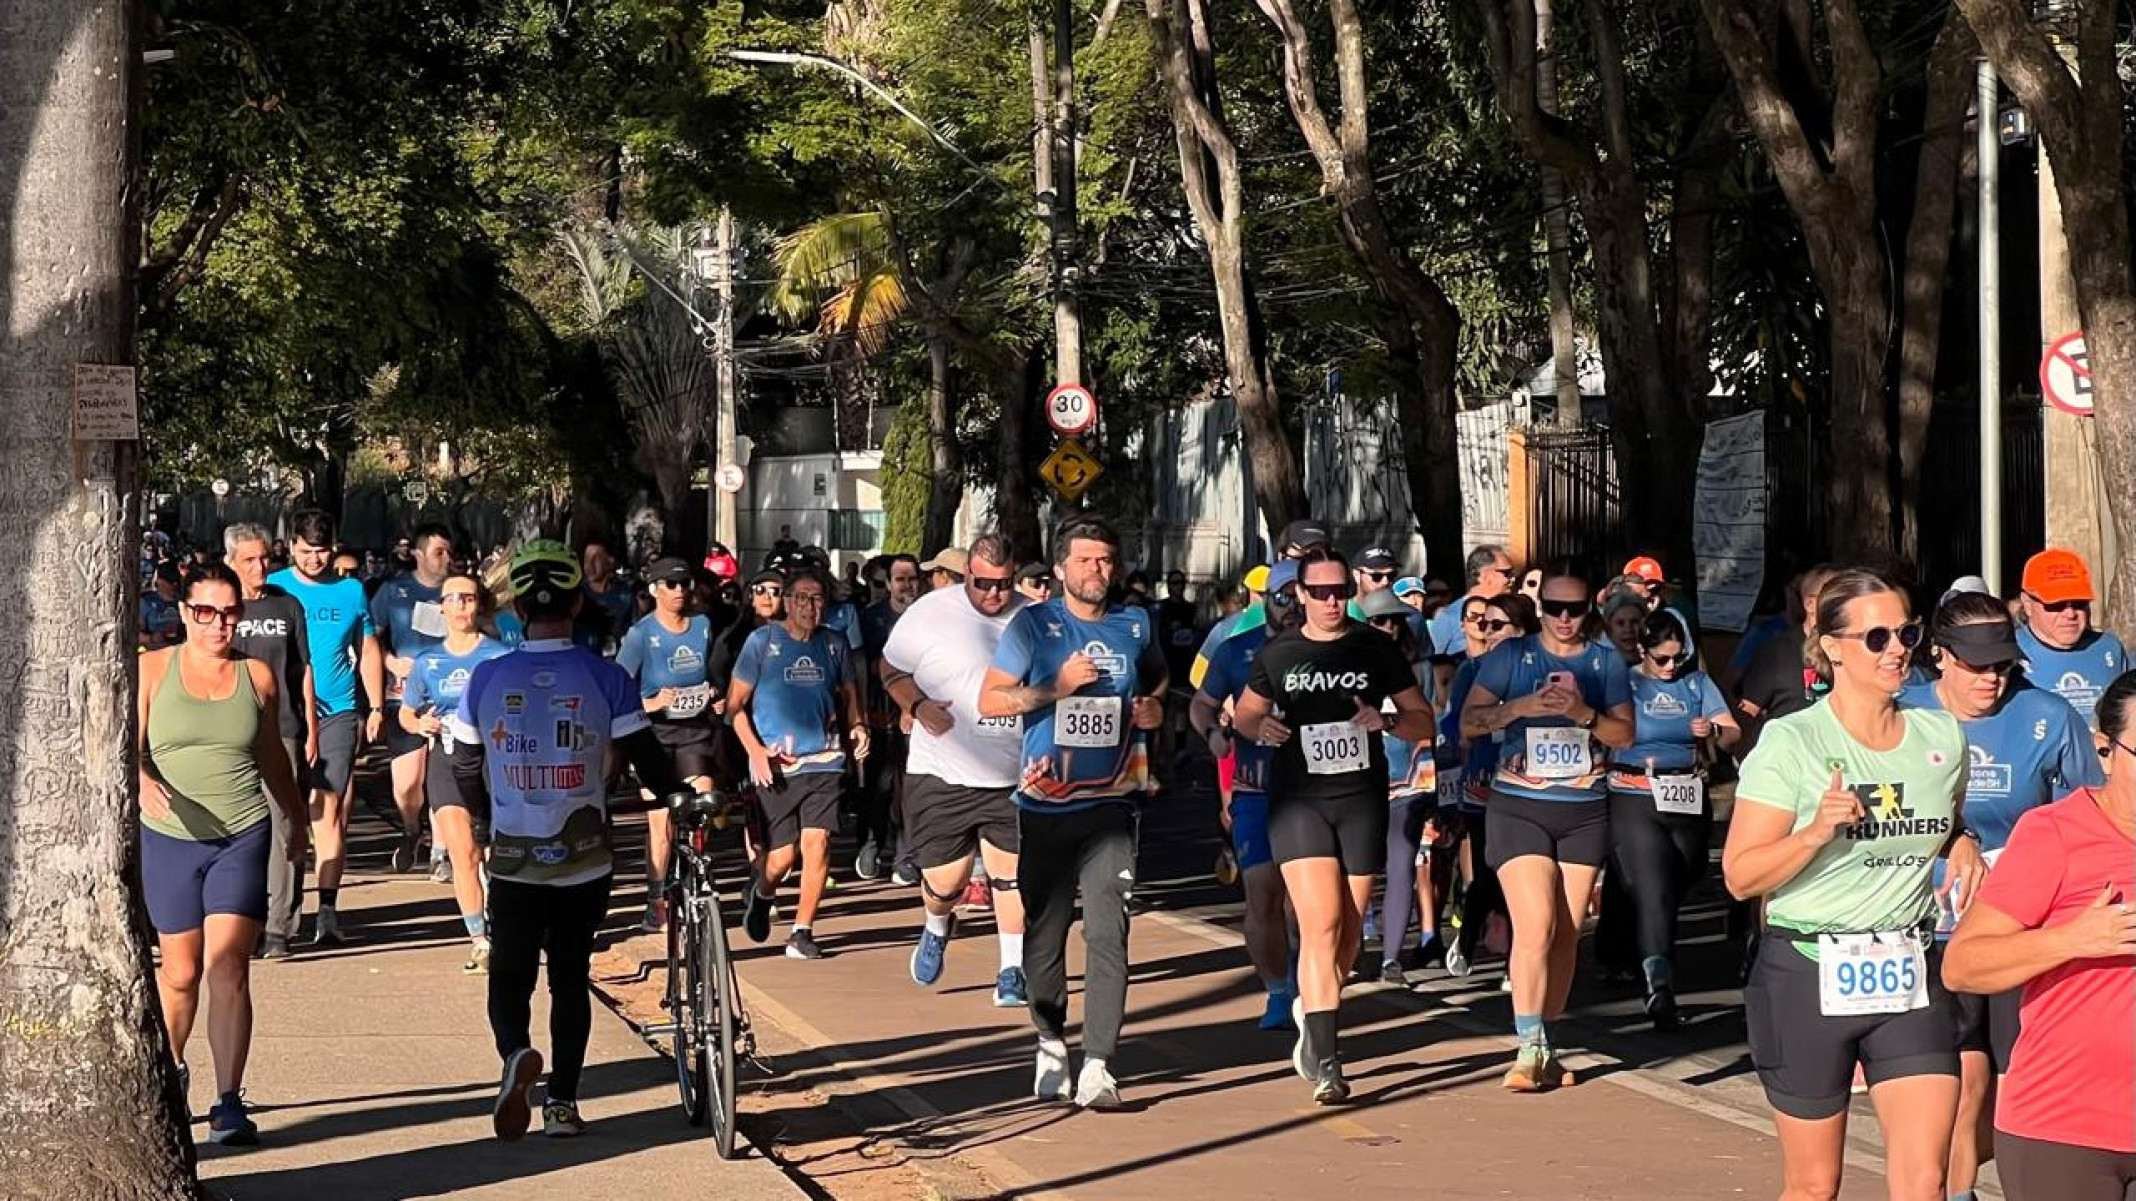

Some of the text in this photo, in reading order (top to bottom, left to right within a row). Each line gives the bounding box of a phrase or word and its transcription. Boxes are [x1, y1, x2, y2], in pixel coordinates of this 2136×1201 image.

[1056, 395, 1083, 413] 30
[1284, 671, 1369, 692] BRAVOS
[1065, 713, 1113, 735] 3885
[1312, 736, 1359, 761] 3003
[1535, 743, 1583, 765] 9502
[1660, 785, 1696, 803] 2208
[1846, 816, 1950, 840] RUNNERS
[1836, 956, 1916, 996] 9865
